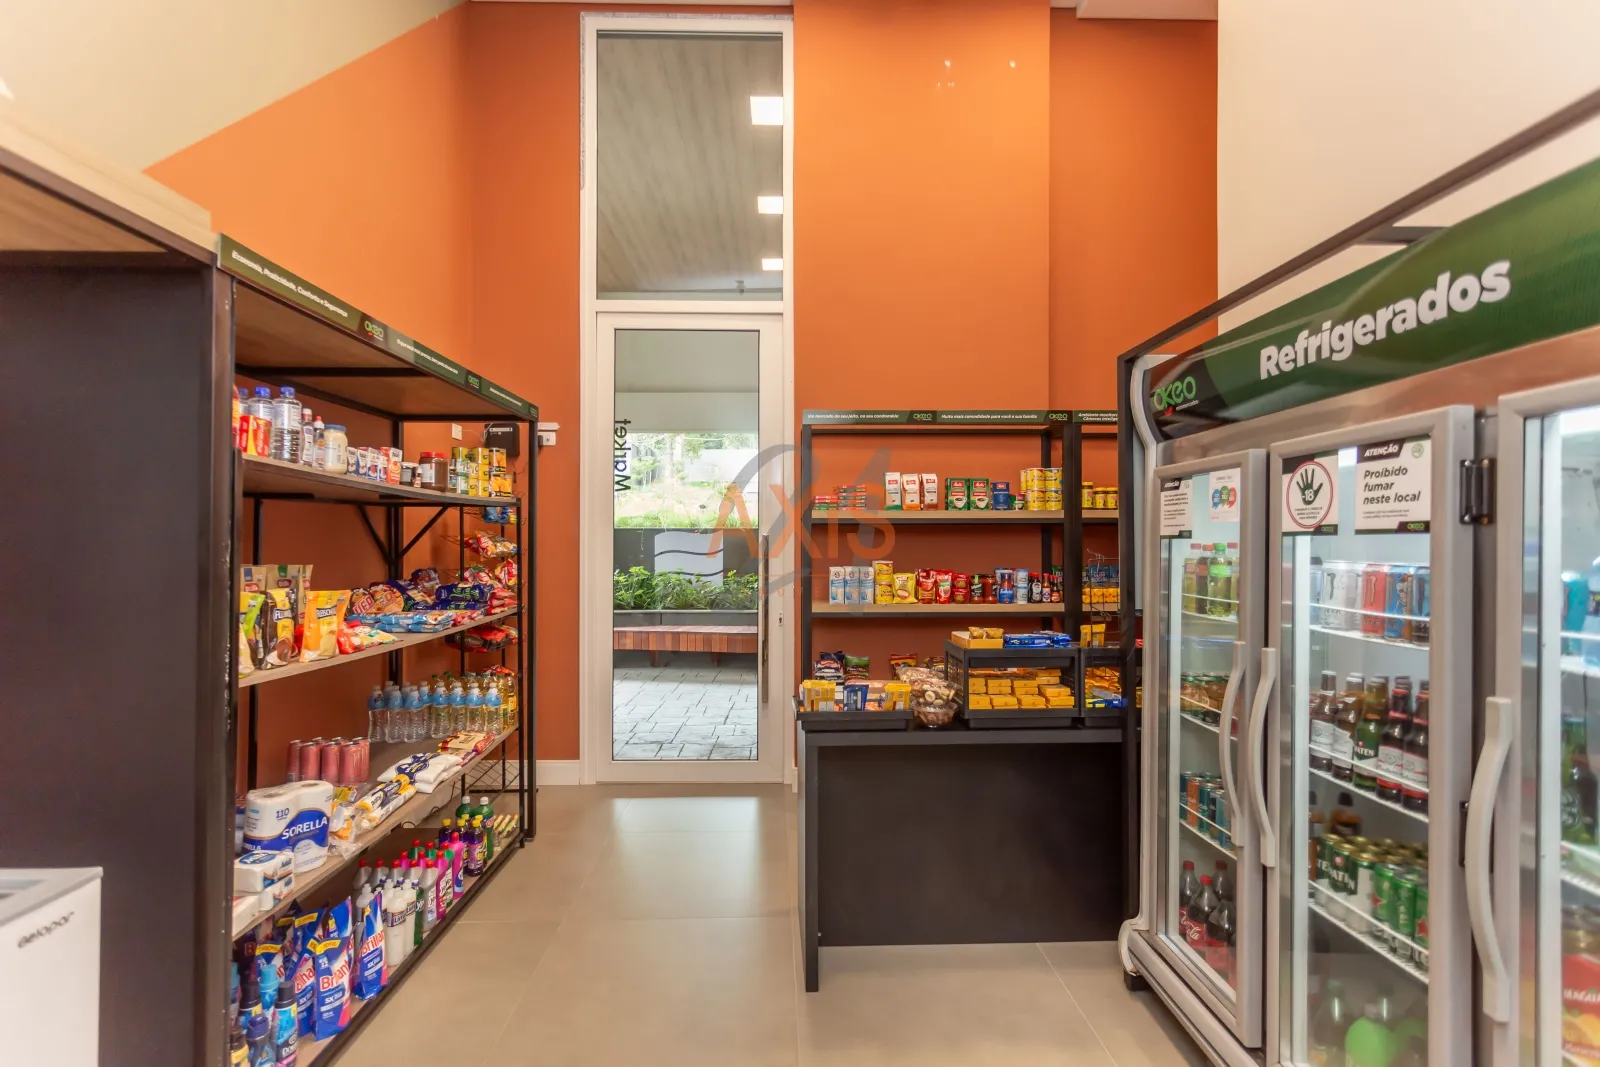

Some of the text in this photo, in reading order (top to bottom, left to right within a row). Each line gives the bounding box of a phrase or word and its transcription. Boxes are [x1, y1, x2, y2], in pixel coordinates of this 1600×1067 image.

[1259, 259, 1511, 380] Refrigerados
[1363, 443, 1399, 458] ATENÇÃO
[1363, 465, 1408, 480] Proibido
[1363, 481, 1395, 493] fumar
[1363, 490, 1421, 505] neste local
[275, 808, 290, 819] 110
[281, 816, 328, 841] SORELLA
